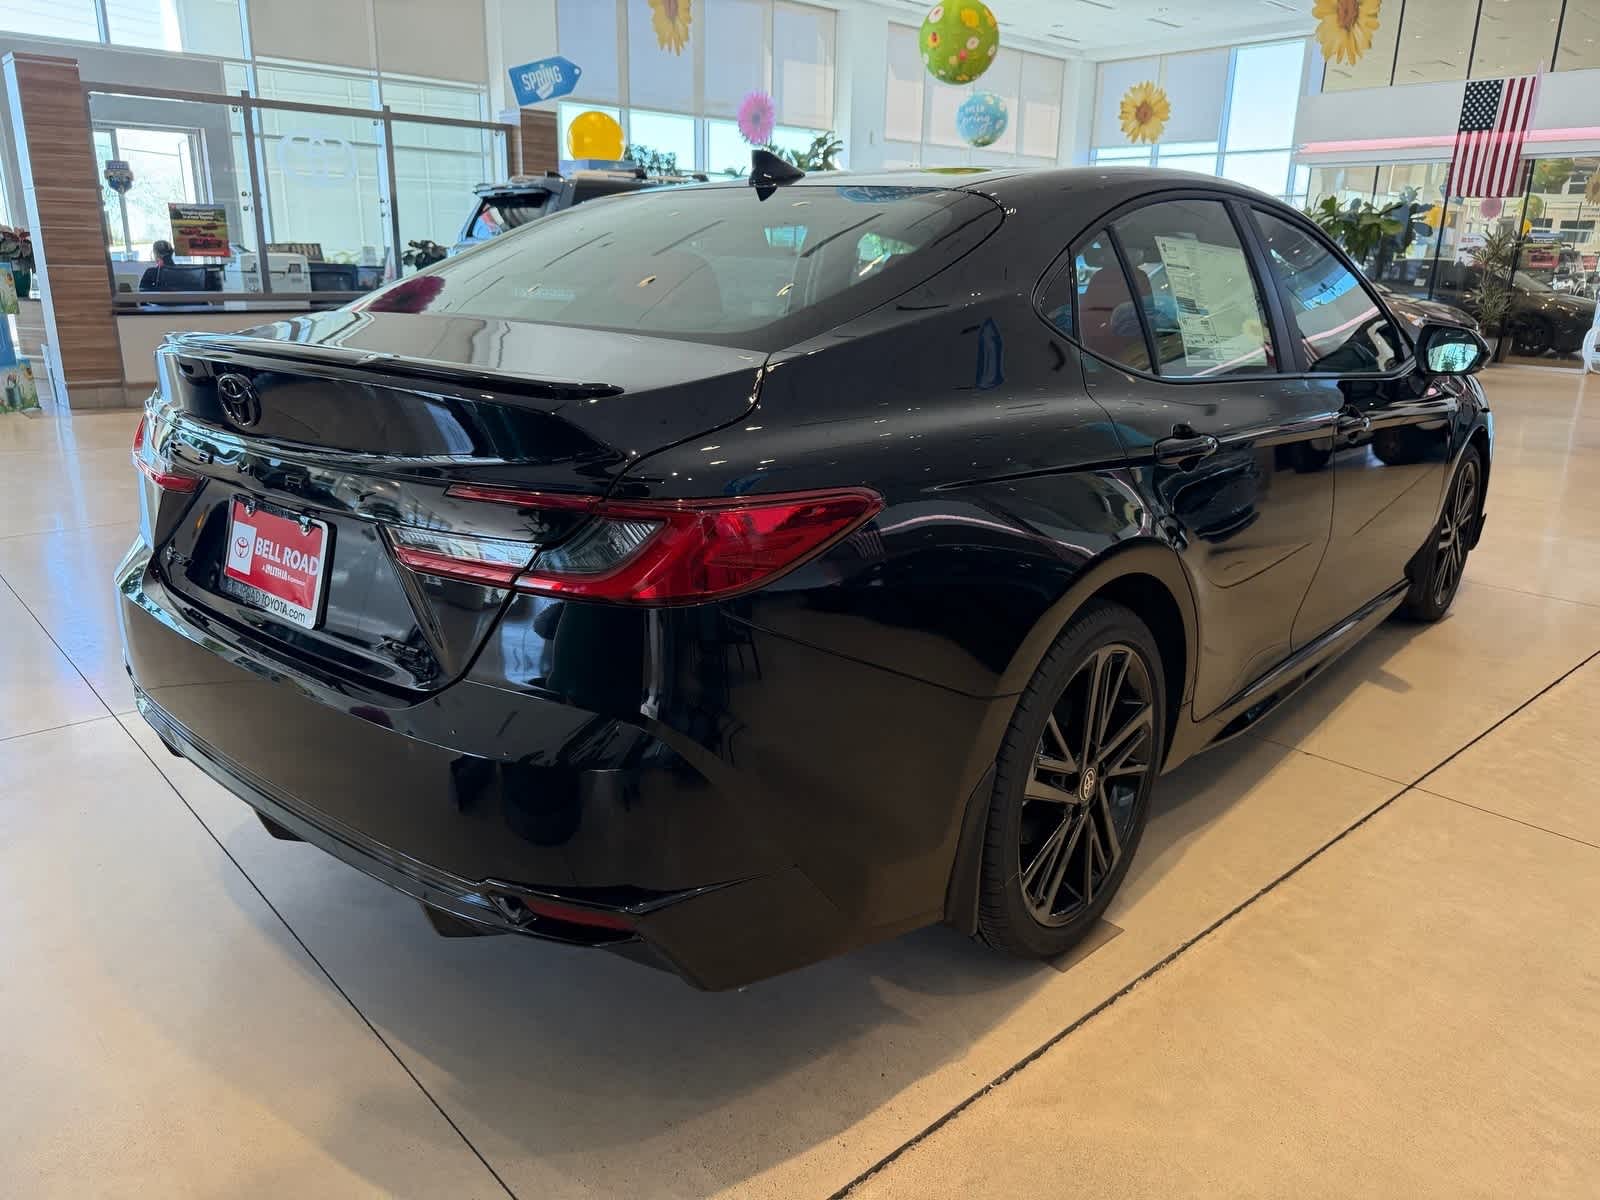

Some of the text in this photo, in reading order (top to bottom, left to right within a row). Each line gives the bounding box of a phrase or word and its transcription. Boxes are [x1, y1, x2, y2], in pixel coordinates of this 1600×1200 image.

[521, 65, 563, 91] SPRING
[255, 537, 320, 576] BELL ROAD
